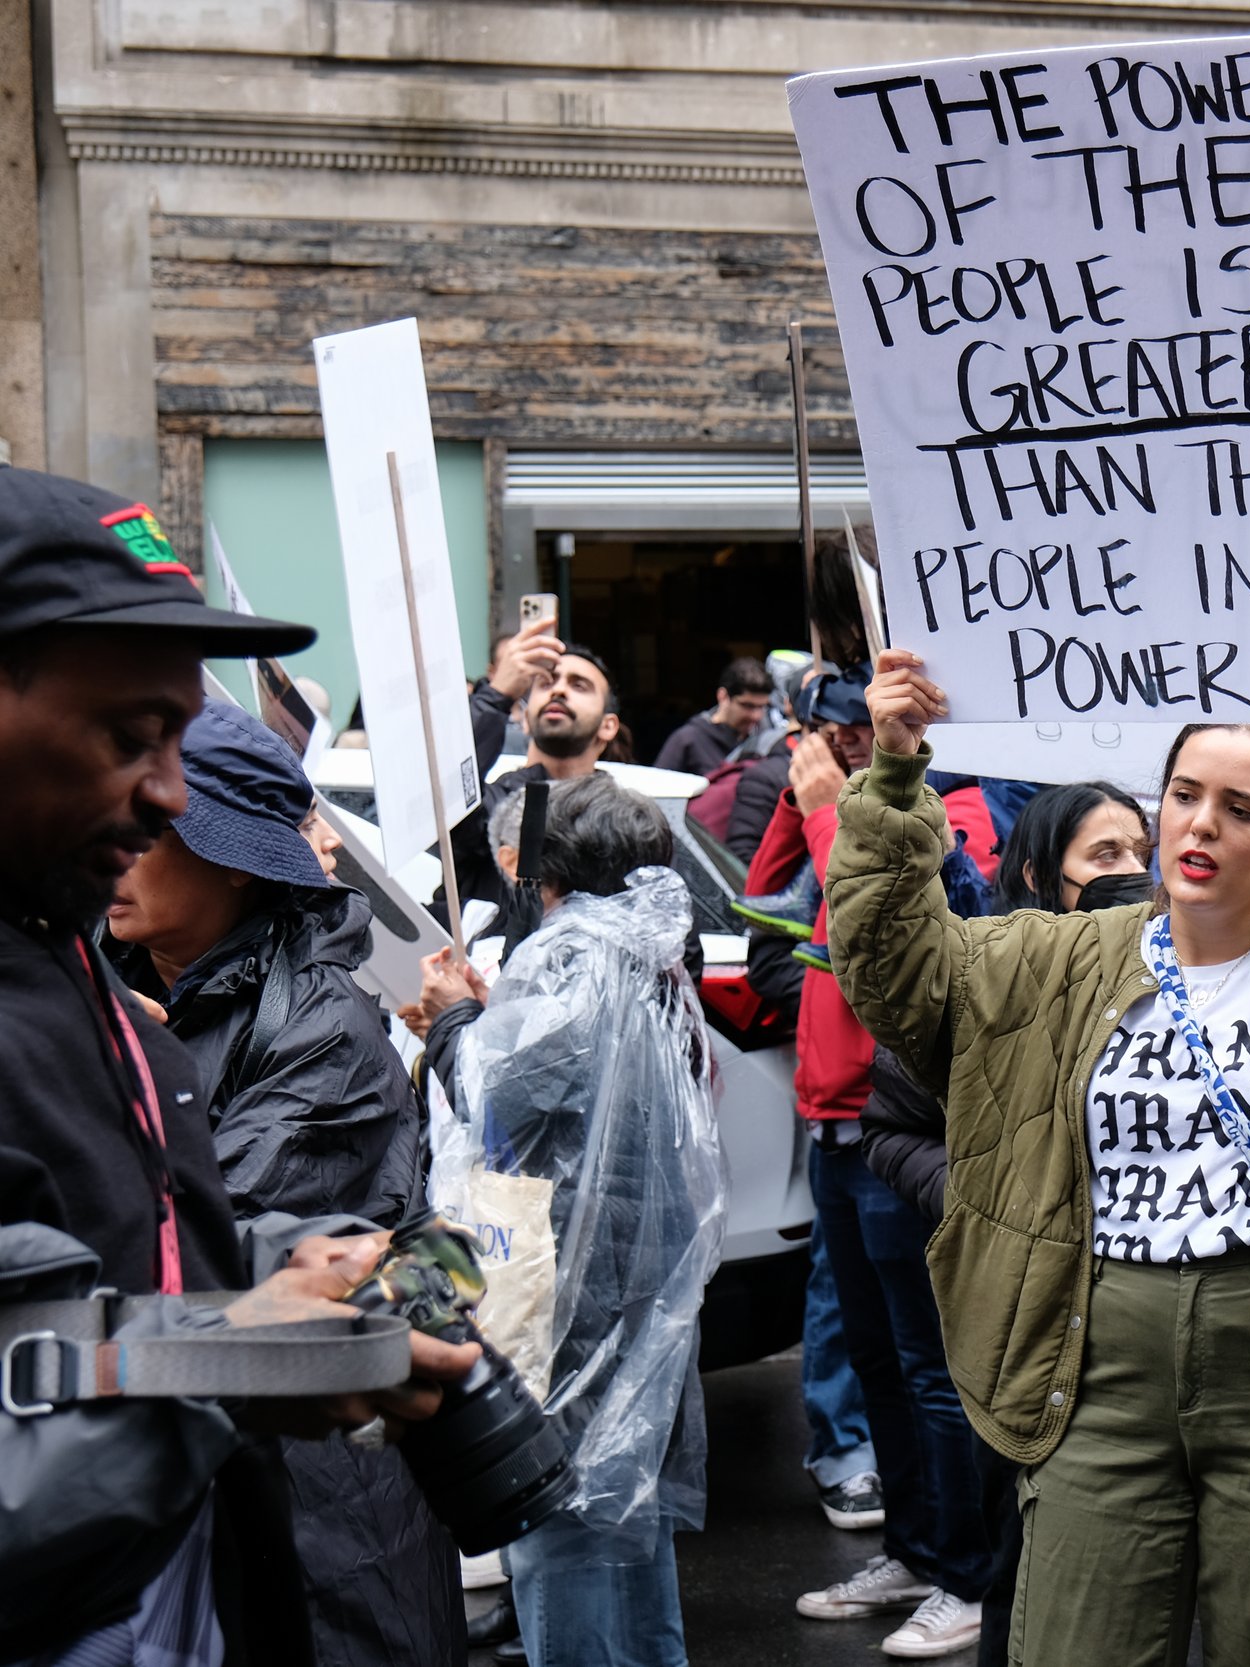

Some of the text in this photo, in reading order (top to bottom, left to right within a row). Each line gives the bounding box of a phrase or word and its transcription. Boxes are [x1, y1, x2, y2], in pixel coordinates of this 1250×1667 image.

[834, 64, 1064, 153] THE
[856, 159, 996, 257] OF
[862, 255, 1125, 347] PEOPLE
[916, 443, 1156, 531] THAN
[914, 539, 1142, 632] PEOPLE
